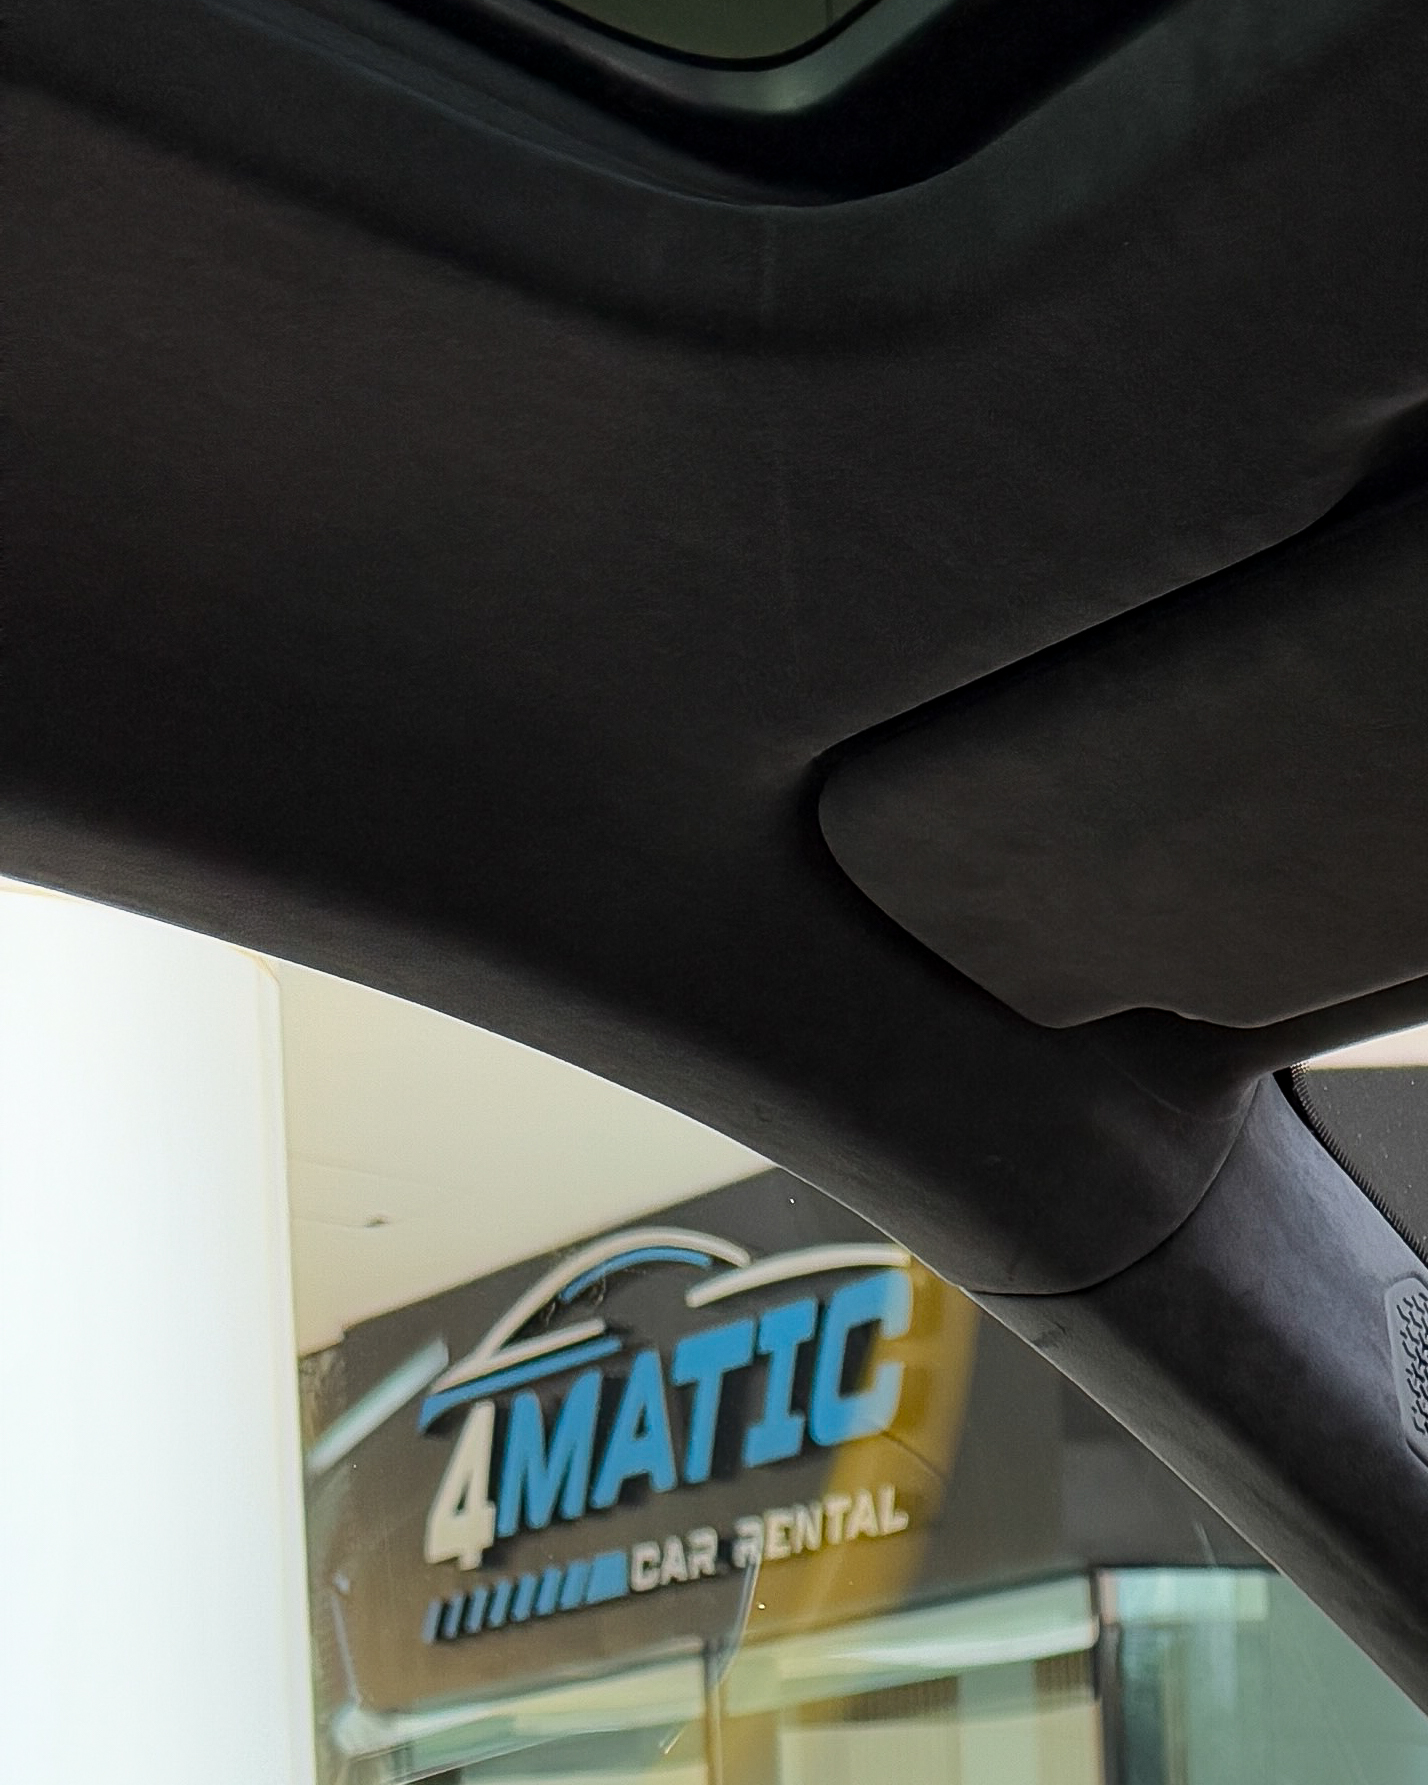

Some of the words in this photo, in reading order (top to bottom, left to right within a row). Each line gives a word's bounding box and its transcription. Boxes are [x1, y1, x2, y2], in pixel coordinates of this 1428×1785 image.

[424, 1269, 912, 1570] 4MATIC
[629, 1525, 721, 1593] CAR
[731, 1486, 909, 1566] RENTAL
